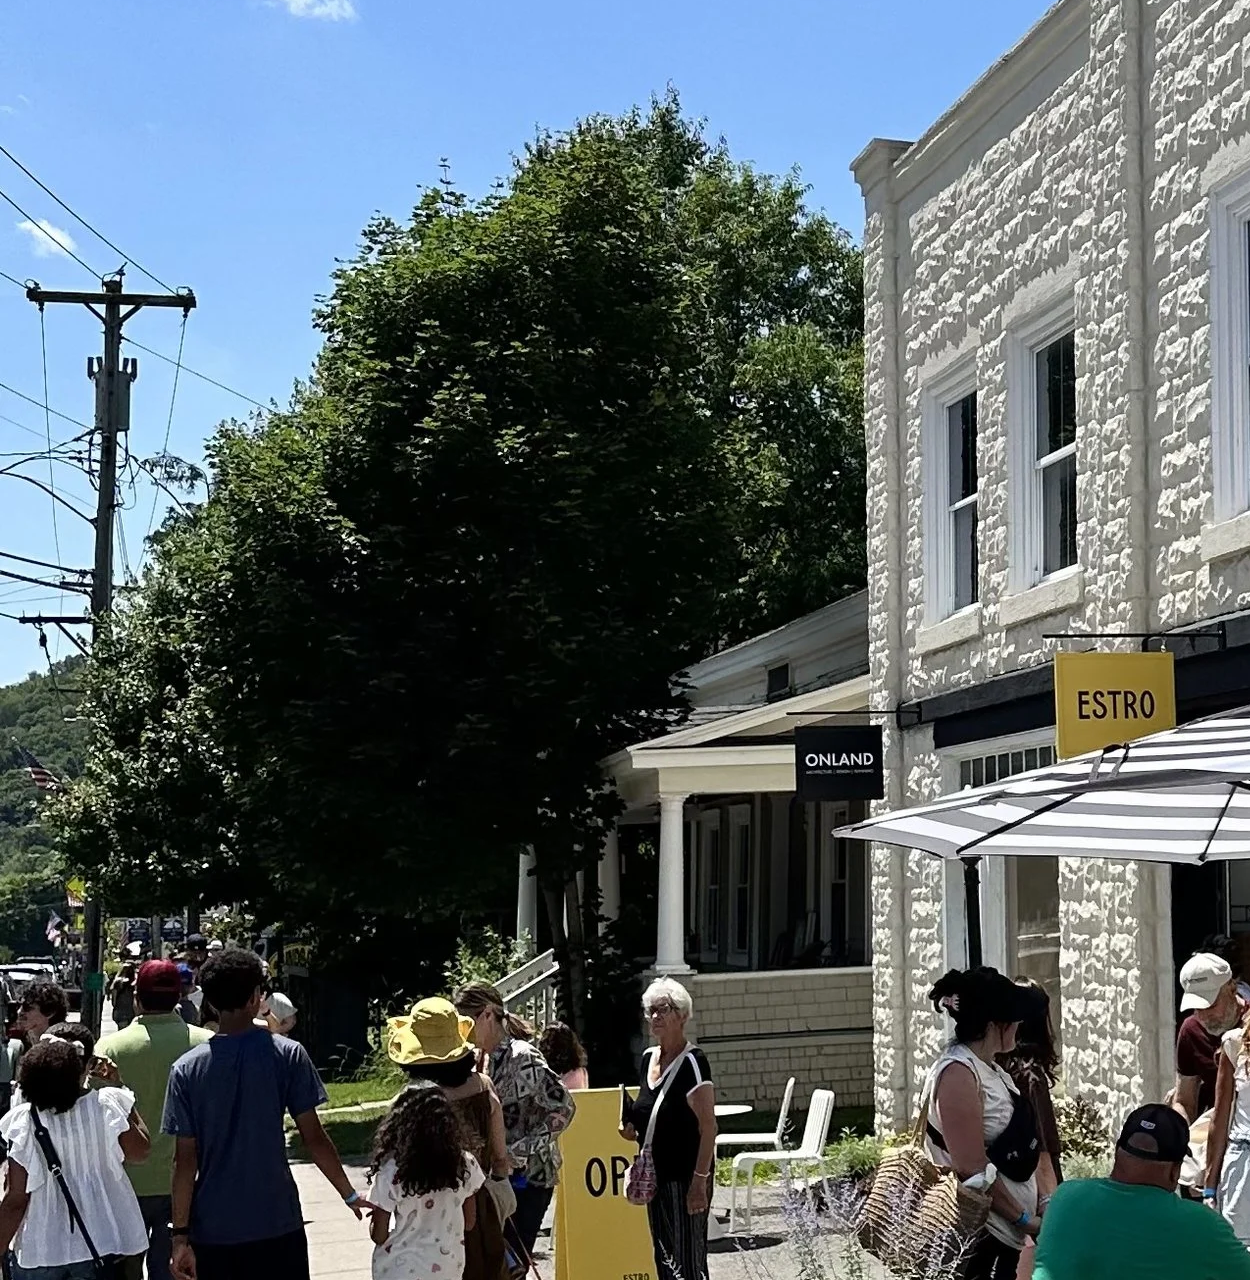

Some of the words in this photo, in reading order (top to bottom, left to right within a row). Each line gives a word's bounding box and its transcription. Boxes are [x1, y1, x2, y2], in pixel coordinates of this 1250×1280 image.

[1077, 689, 1156, 720] ESTRO
[805, 752, 874, 767] ONLAND
[585, 1155, 639, 1198] OP
